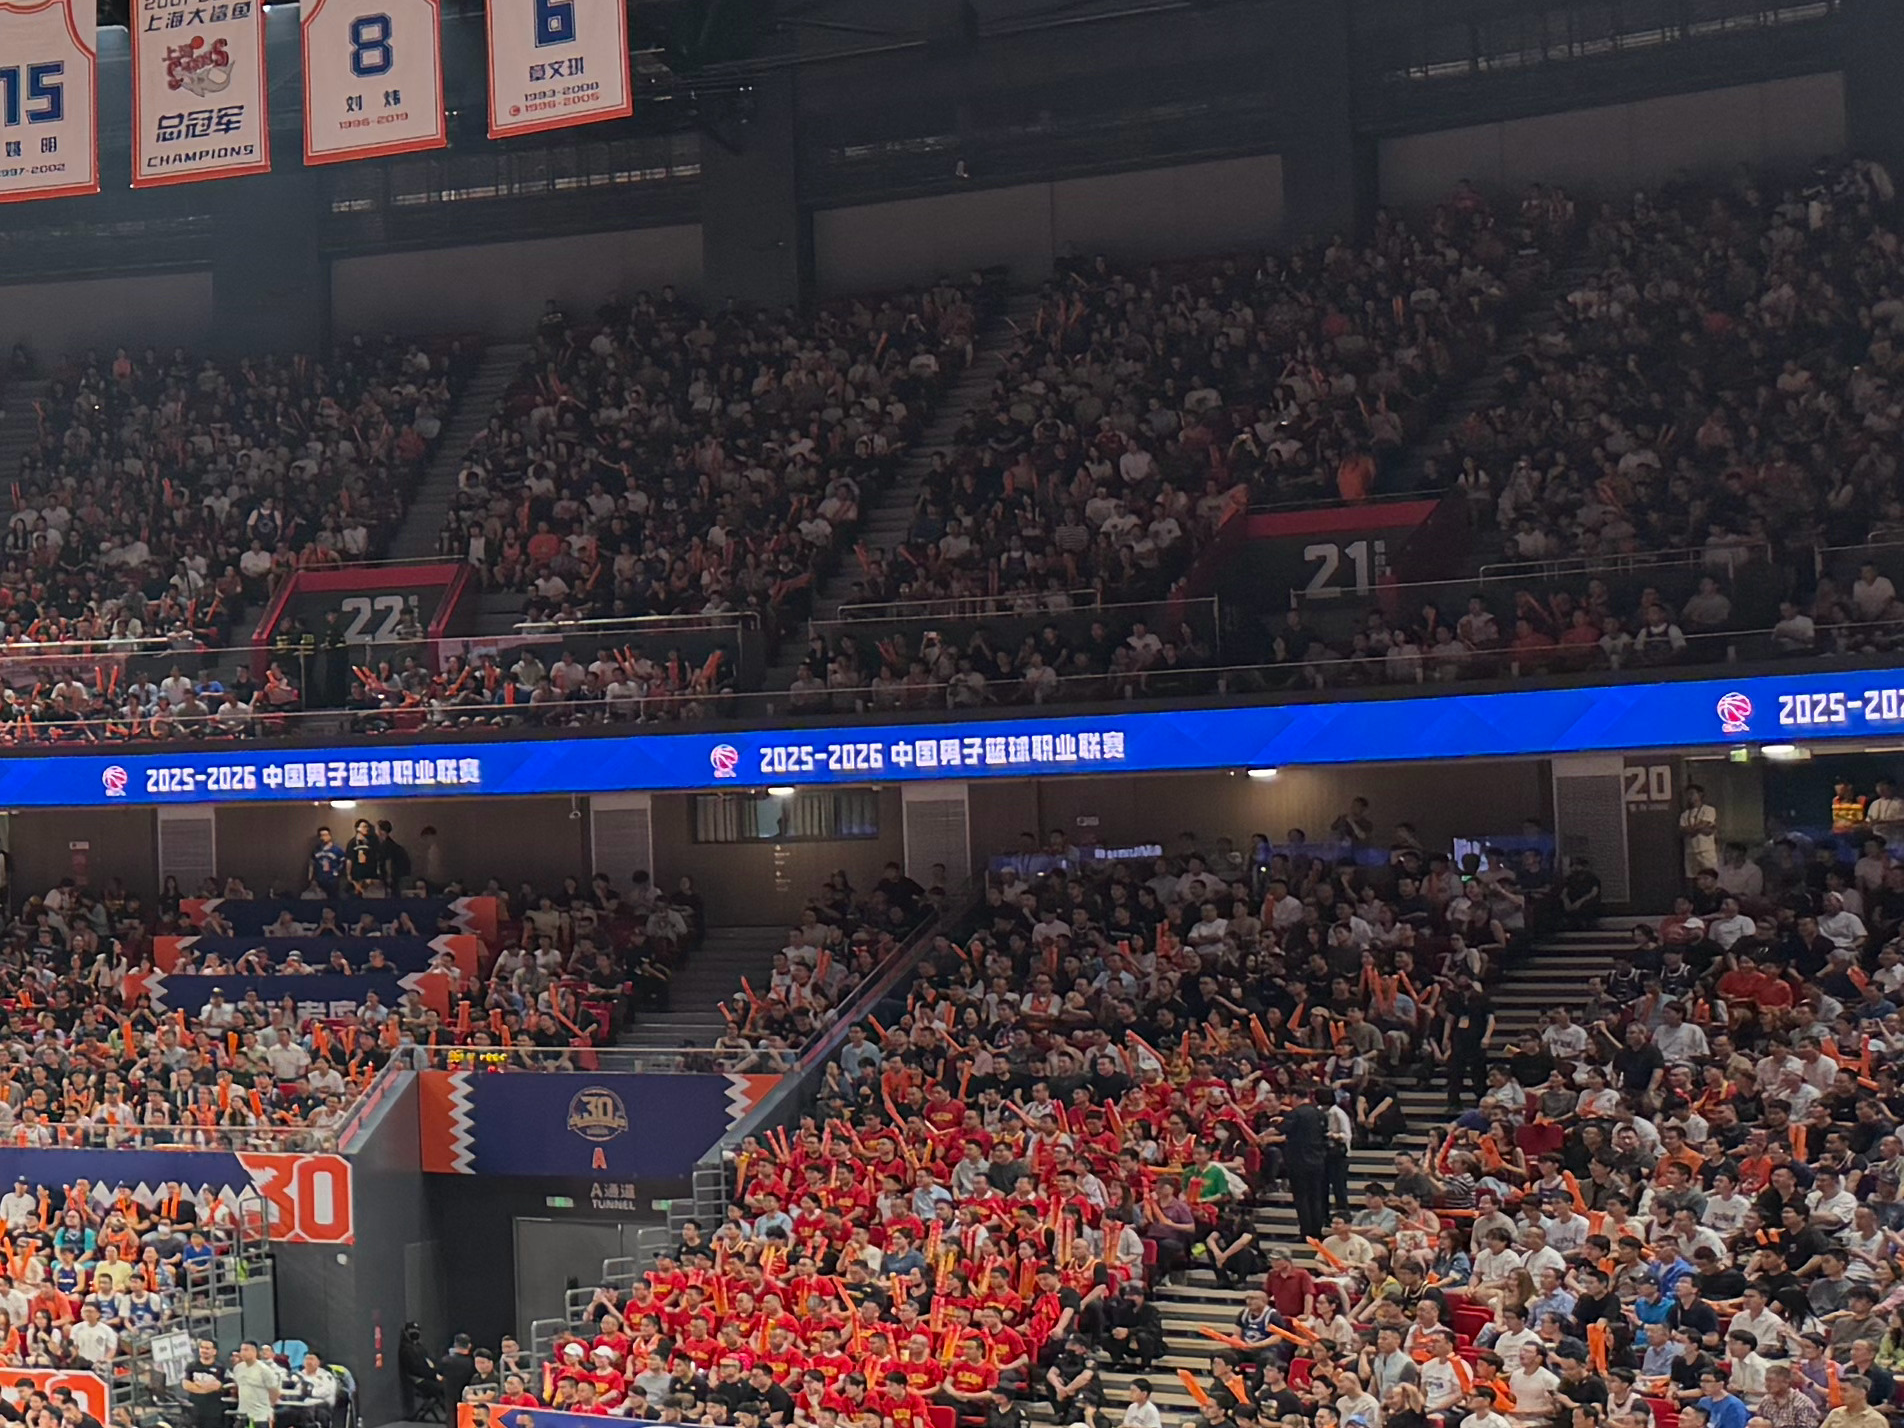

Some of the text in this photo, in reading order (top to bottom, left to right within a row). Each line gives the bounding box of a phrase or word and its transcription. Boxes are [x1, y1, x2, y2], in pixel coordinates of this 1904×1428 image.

[143, 0, 252, 33] 上海大鲨鱼
[349, 14, 393, 78] 8
[155, 105, 245, 144] 总冠军
[5, 136, 58, 157] 姚明
[146, 144, 255, 169] CHAMPIONS
[1303, 539, 1369, 599] 21
[341, 596, 404, 644] 22
[759, 730, 1127, 775] 2025-2026 中国男子篮球职业联赛
[146, 757, 482, 793] 2025-2026 中国男子篮球职业联赛
[1625, 765, 1672, 801] 20
[582, 1097, 615, 1119] 30
[592, 1148, 607, 1169] A
[238, 1153, 354, 1244] 30
[591, 1199, 636, 1213] TUNNEL
